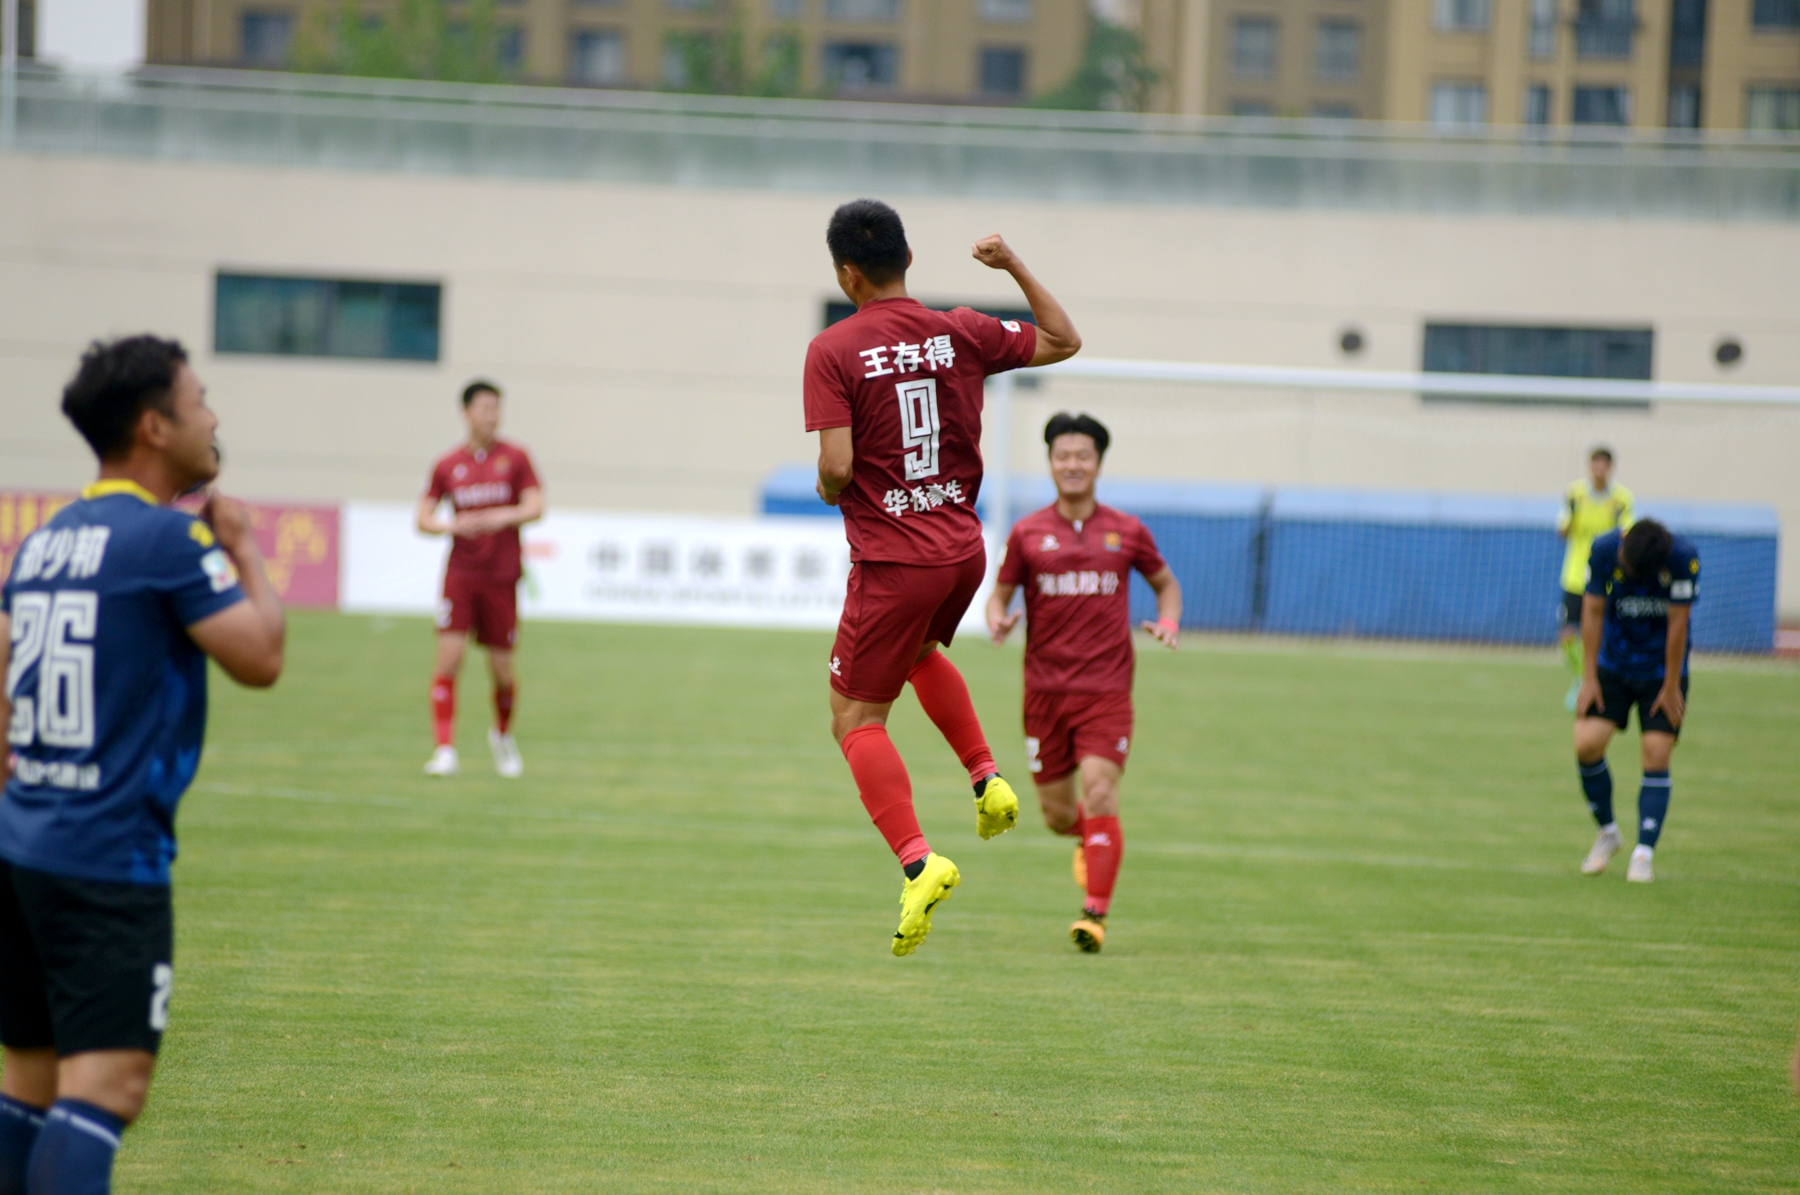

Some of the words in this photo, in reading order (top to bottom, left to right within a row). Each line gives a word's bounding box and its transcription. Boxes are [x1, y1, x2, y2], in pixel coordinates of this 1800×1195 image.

[859, 334, 956, 379] 王存得
[895, 378, 941, 481] 9
[6, 589, 98, 748] 26
